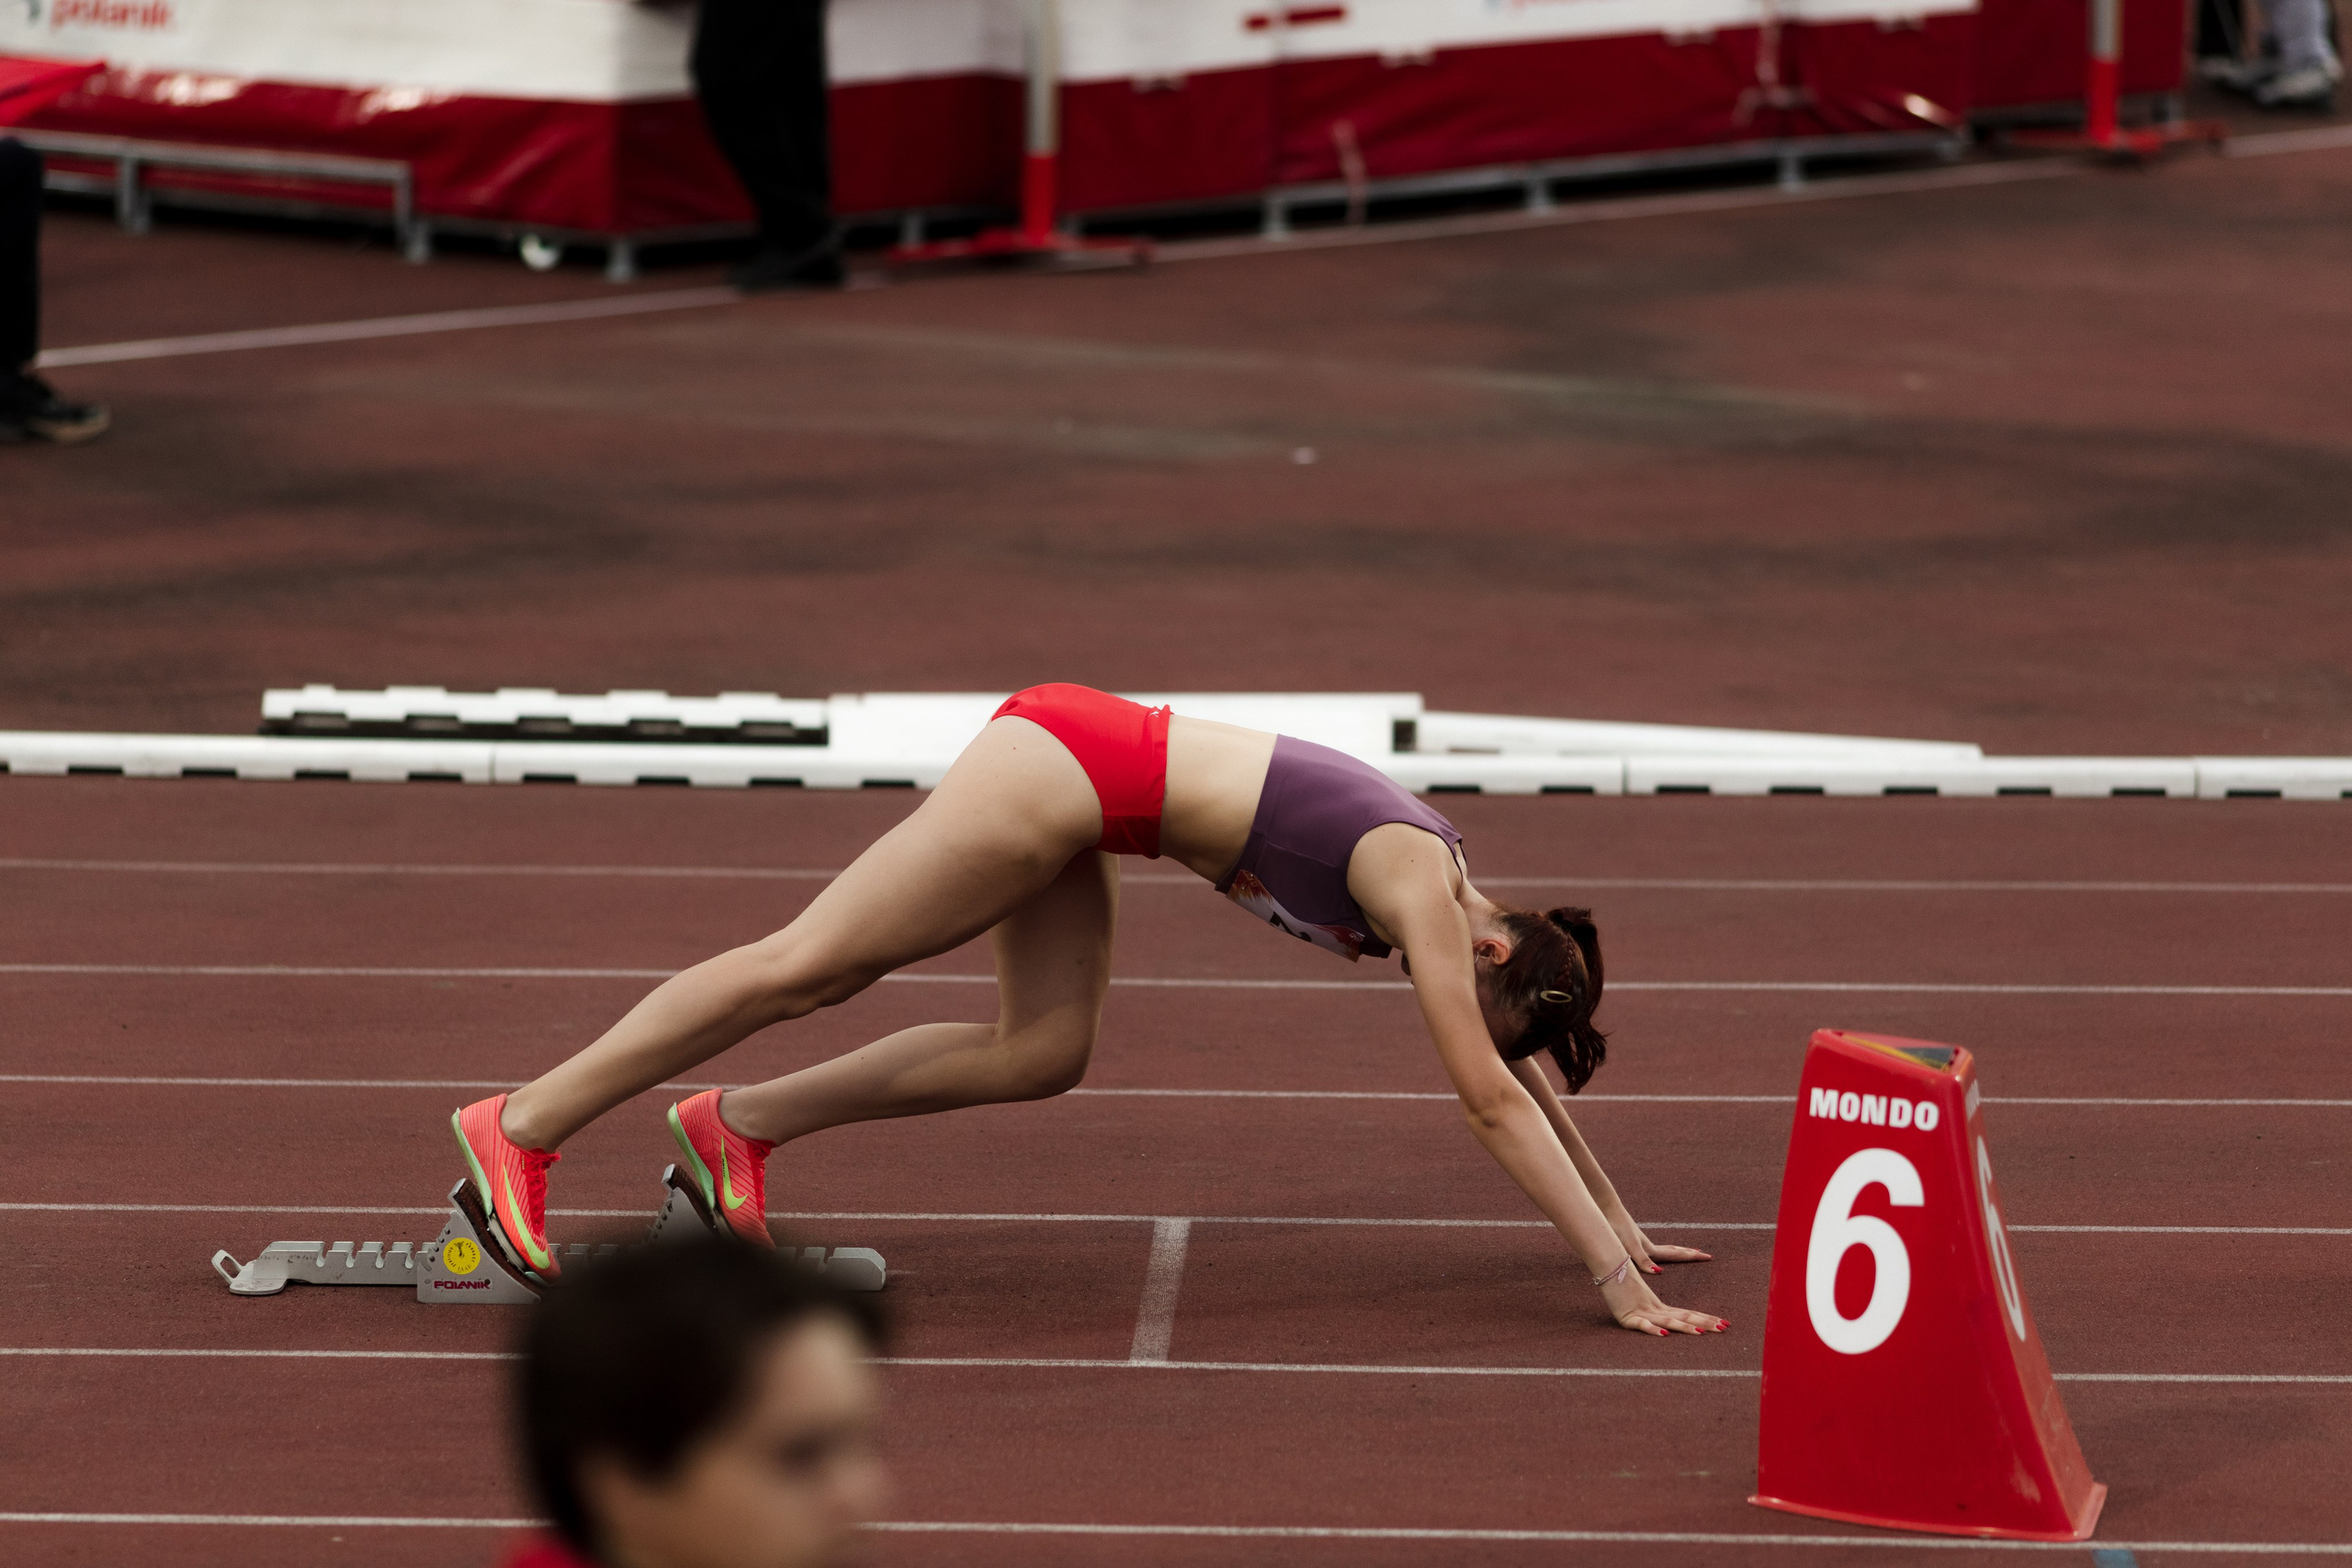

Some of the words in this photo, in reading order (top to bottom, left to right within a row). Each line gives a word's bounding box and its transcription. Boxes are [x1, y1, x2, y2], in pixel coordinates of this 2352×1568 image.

[1809, 1087, 1939, 1132] MONDO
[1805, 1147, 1925, 1355] 6
[1977, 1136, 2026, 1341] 6
[434, 1280, 491, 1290] POLANIK
[458, 1263, 471, 1272] IAAF
